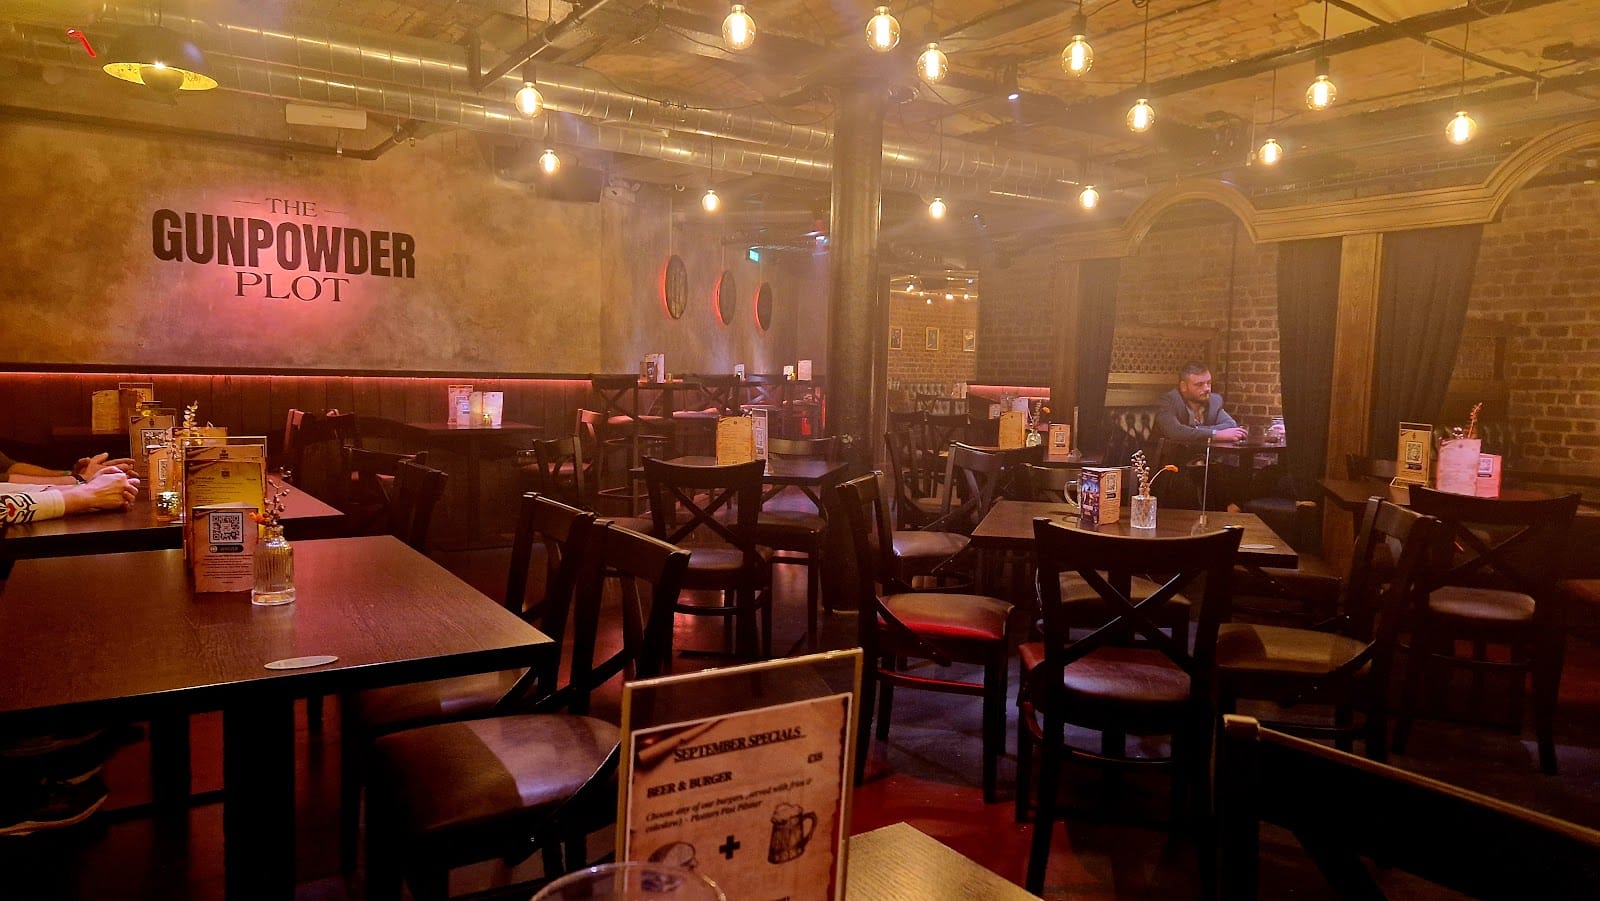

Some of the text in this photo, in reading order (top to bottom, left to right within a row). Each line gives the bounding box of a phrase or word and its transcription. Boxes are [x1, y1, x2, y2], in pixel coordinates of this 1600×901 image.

[265, 197, 318, 217] THE
[152, 208, 416, 279] GUNPOWDER
[234, 271, 350, 302] PLOT
[673, 726, 803, 761] SEPTEMBER SPECIALS
[647, 771, 733, 798] BEER & BURGER
